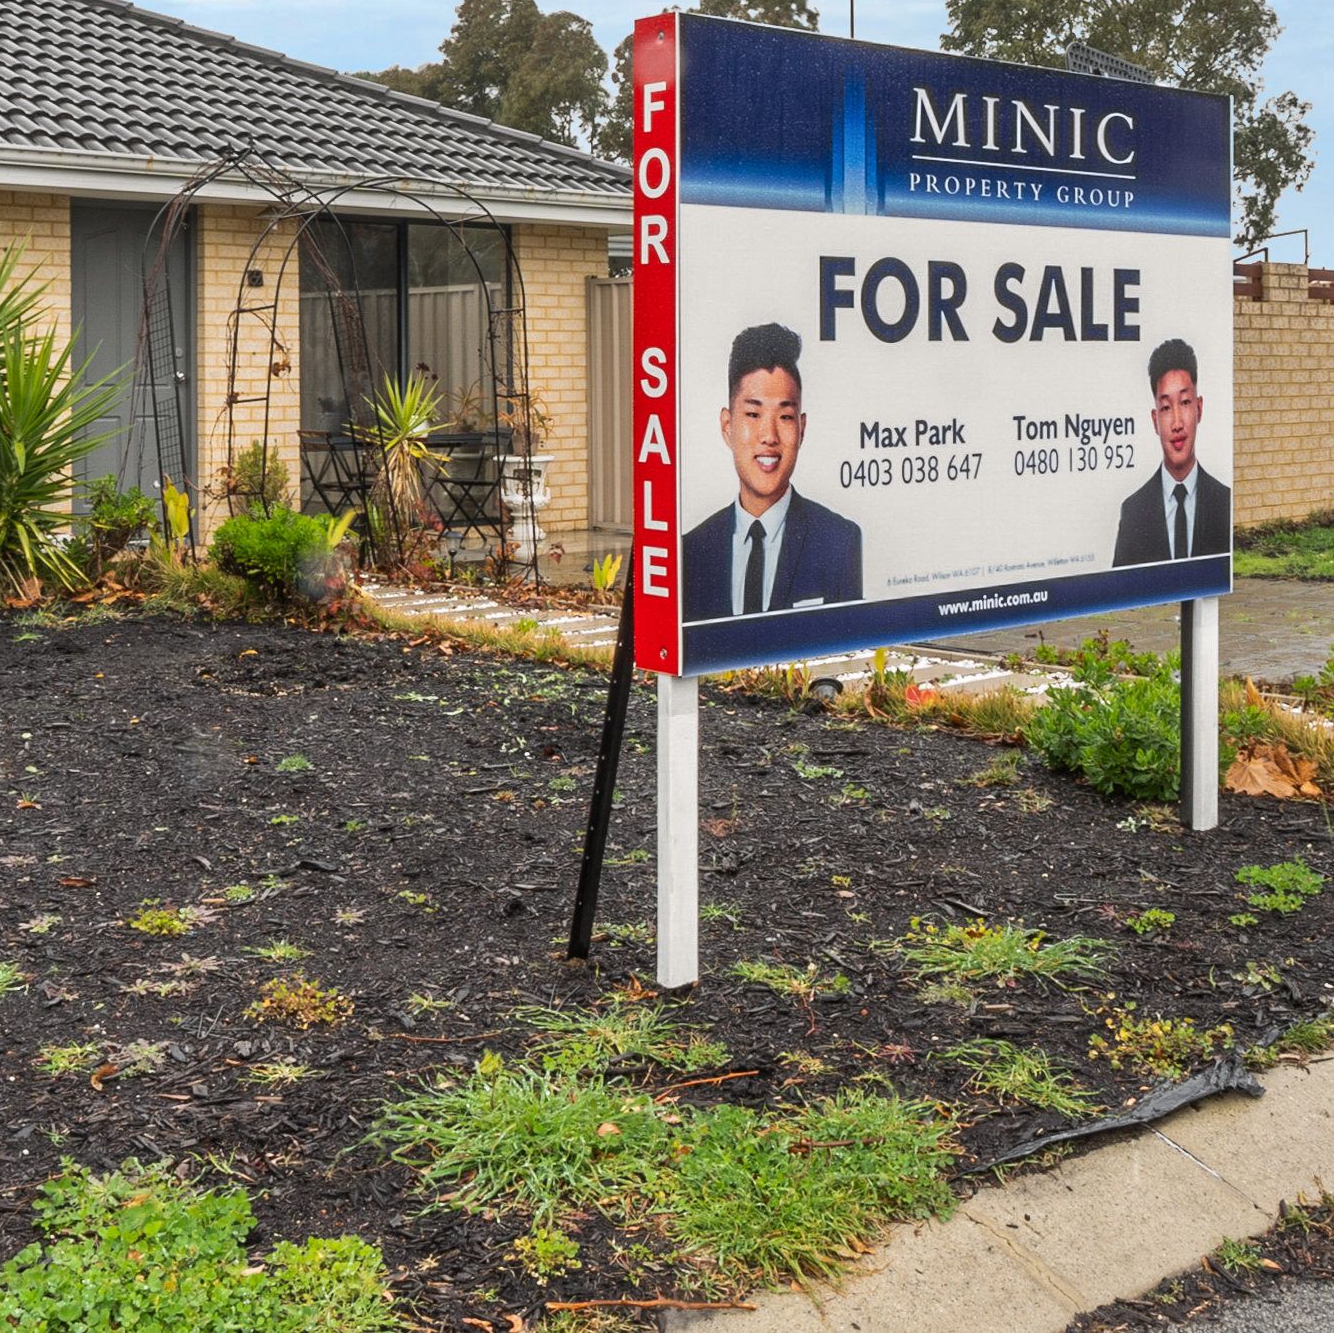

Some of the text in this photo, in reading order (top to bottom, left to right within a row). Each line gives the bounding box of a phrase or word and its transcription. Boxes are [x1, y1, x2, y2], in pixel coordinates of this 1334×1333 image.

[909, 87, 1135, 165] MINIC
[909, 172, 1134, 208] PROPERTY GROUP
[819, 255, 1141, 343] FOR SALE
[638, 81, 672, 598] FOR SALE
[860, 418, 965, 449] Max Park
[1013, 414, 1135, 445] Tom Nguyen
[840, 453, 982, 488] 0403 038 647
[1014, 445, 1135, 476] 0480 130 952
[938, 591, 1048, 616] www.minic.com.au
